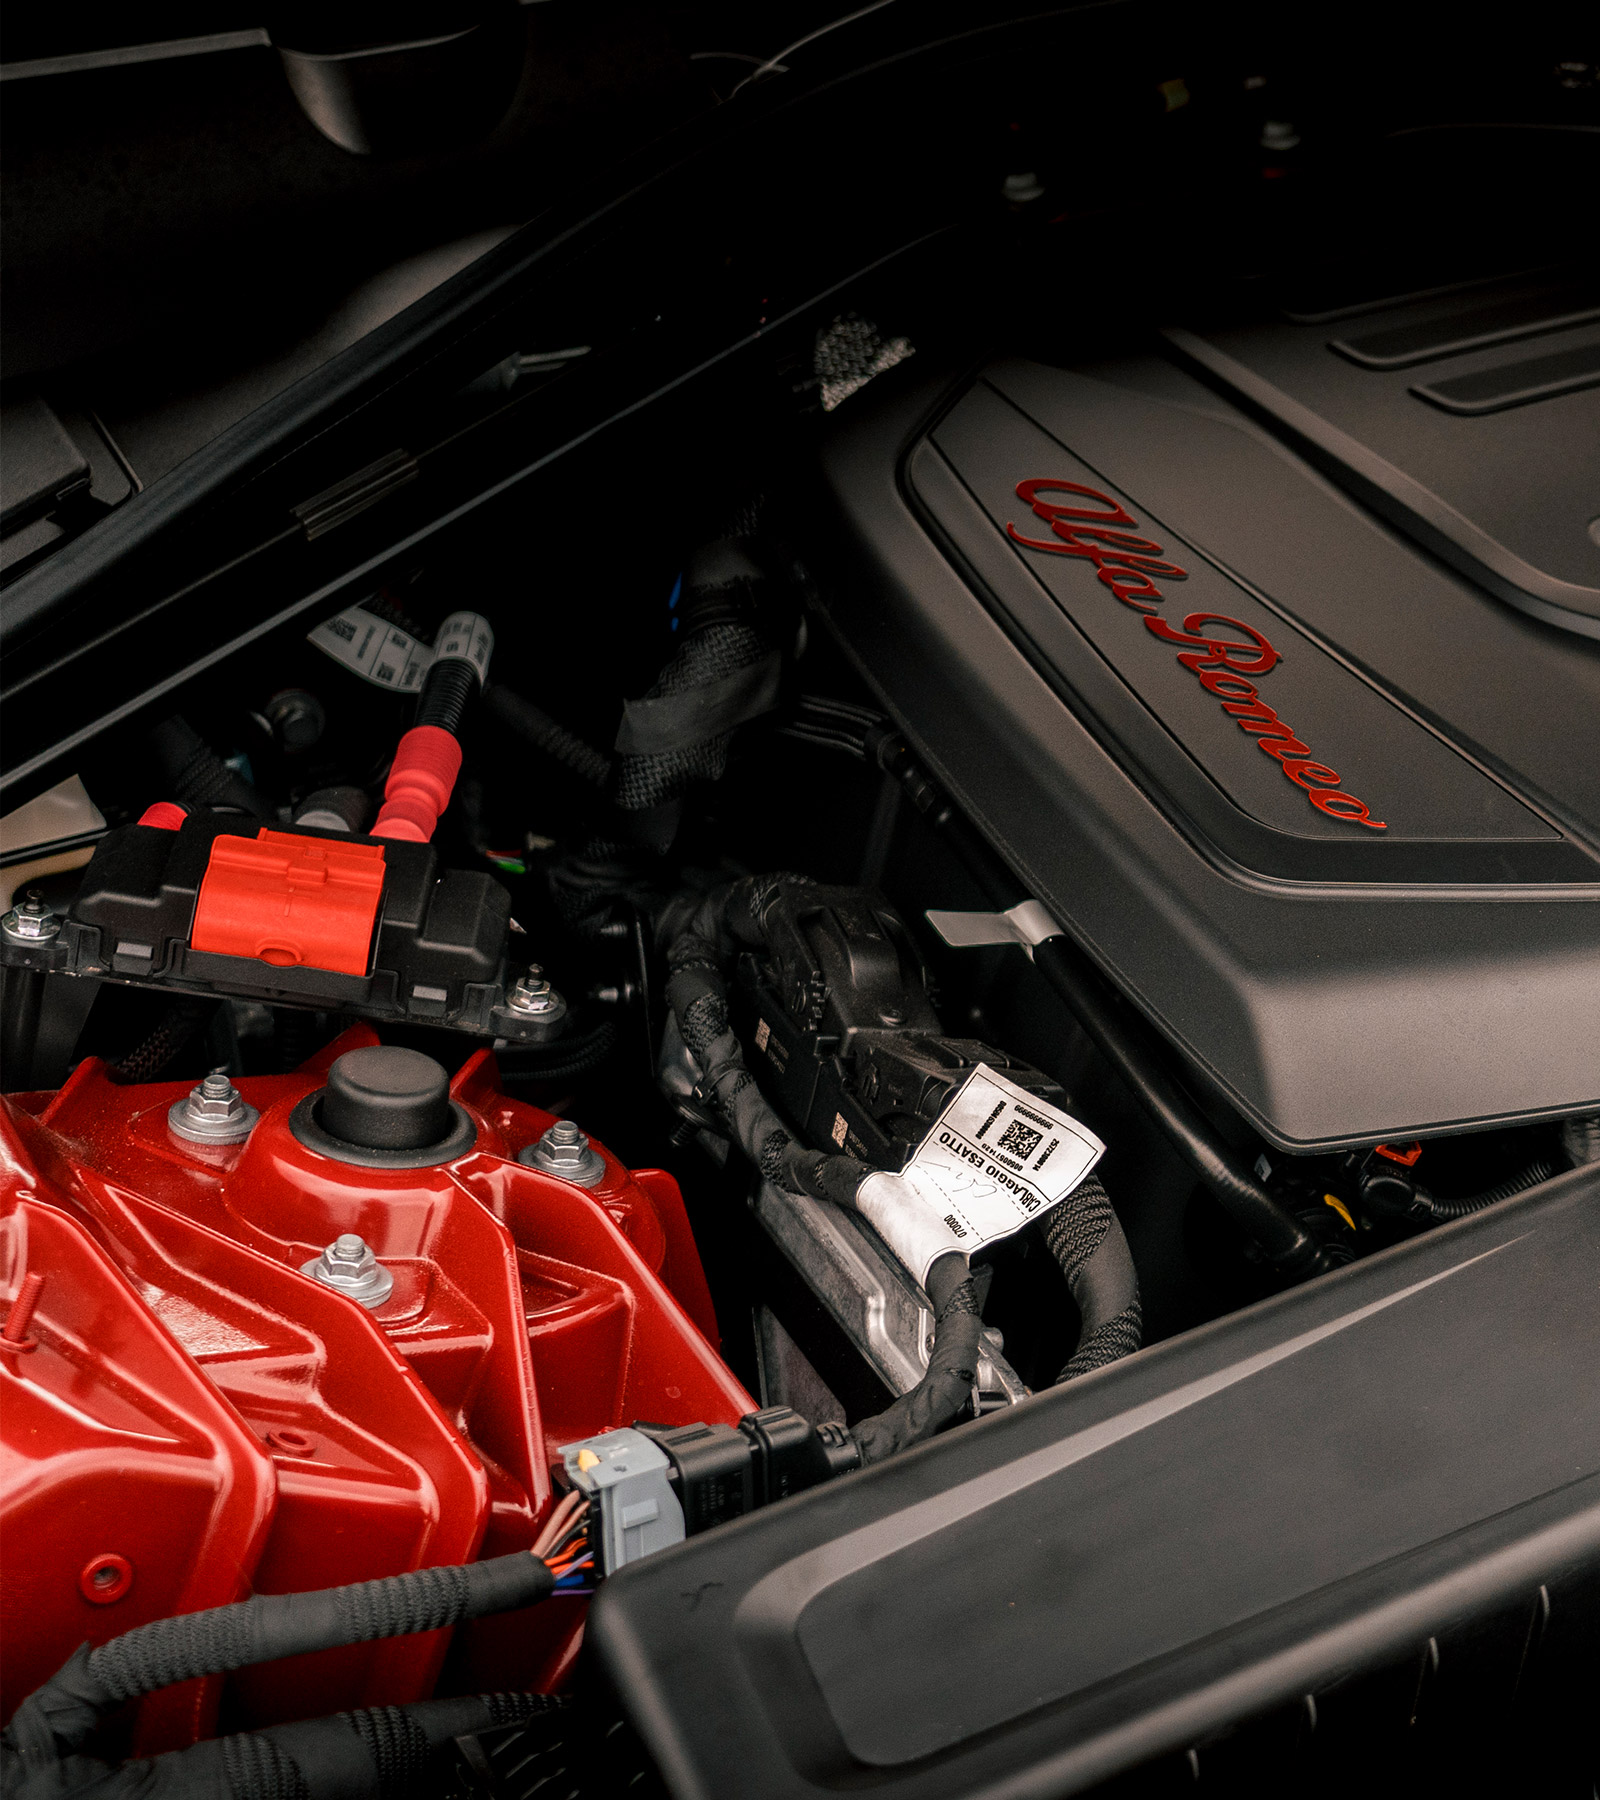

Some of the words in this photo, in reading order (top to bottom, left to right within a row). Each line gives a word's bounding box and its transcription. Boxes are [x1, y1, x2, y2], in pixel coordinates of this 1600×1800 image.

[1006, 479, 1187, 612] Alfa
[1144, 613, 1388, 829] Romeo
[938, 1131, 986, 1169] ESATTO
[985, 1165, 1042, 1213] CABLAGGIO
[943, 1214, 967, 1239] 070000
